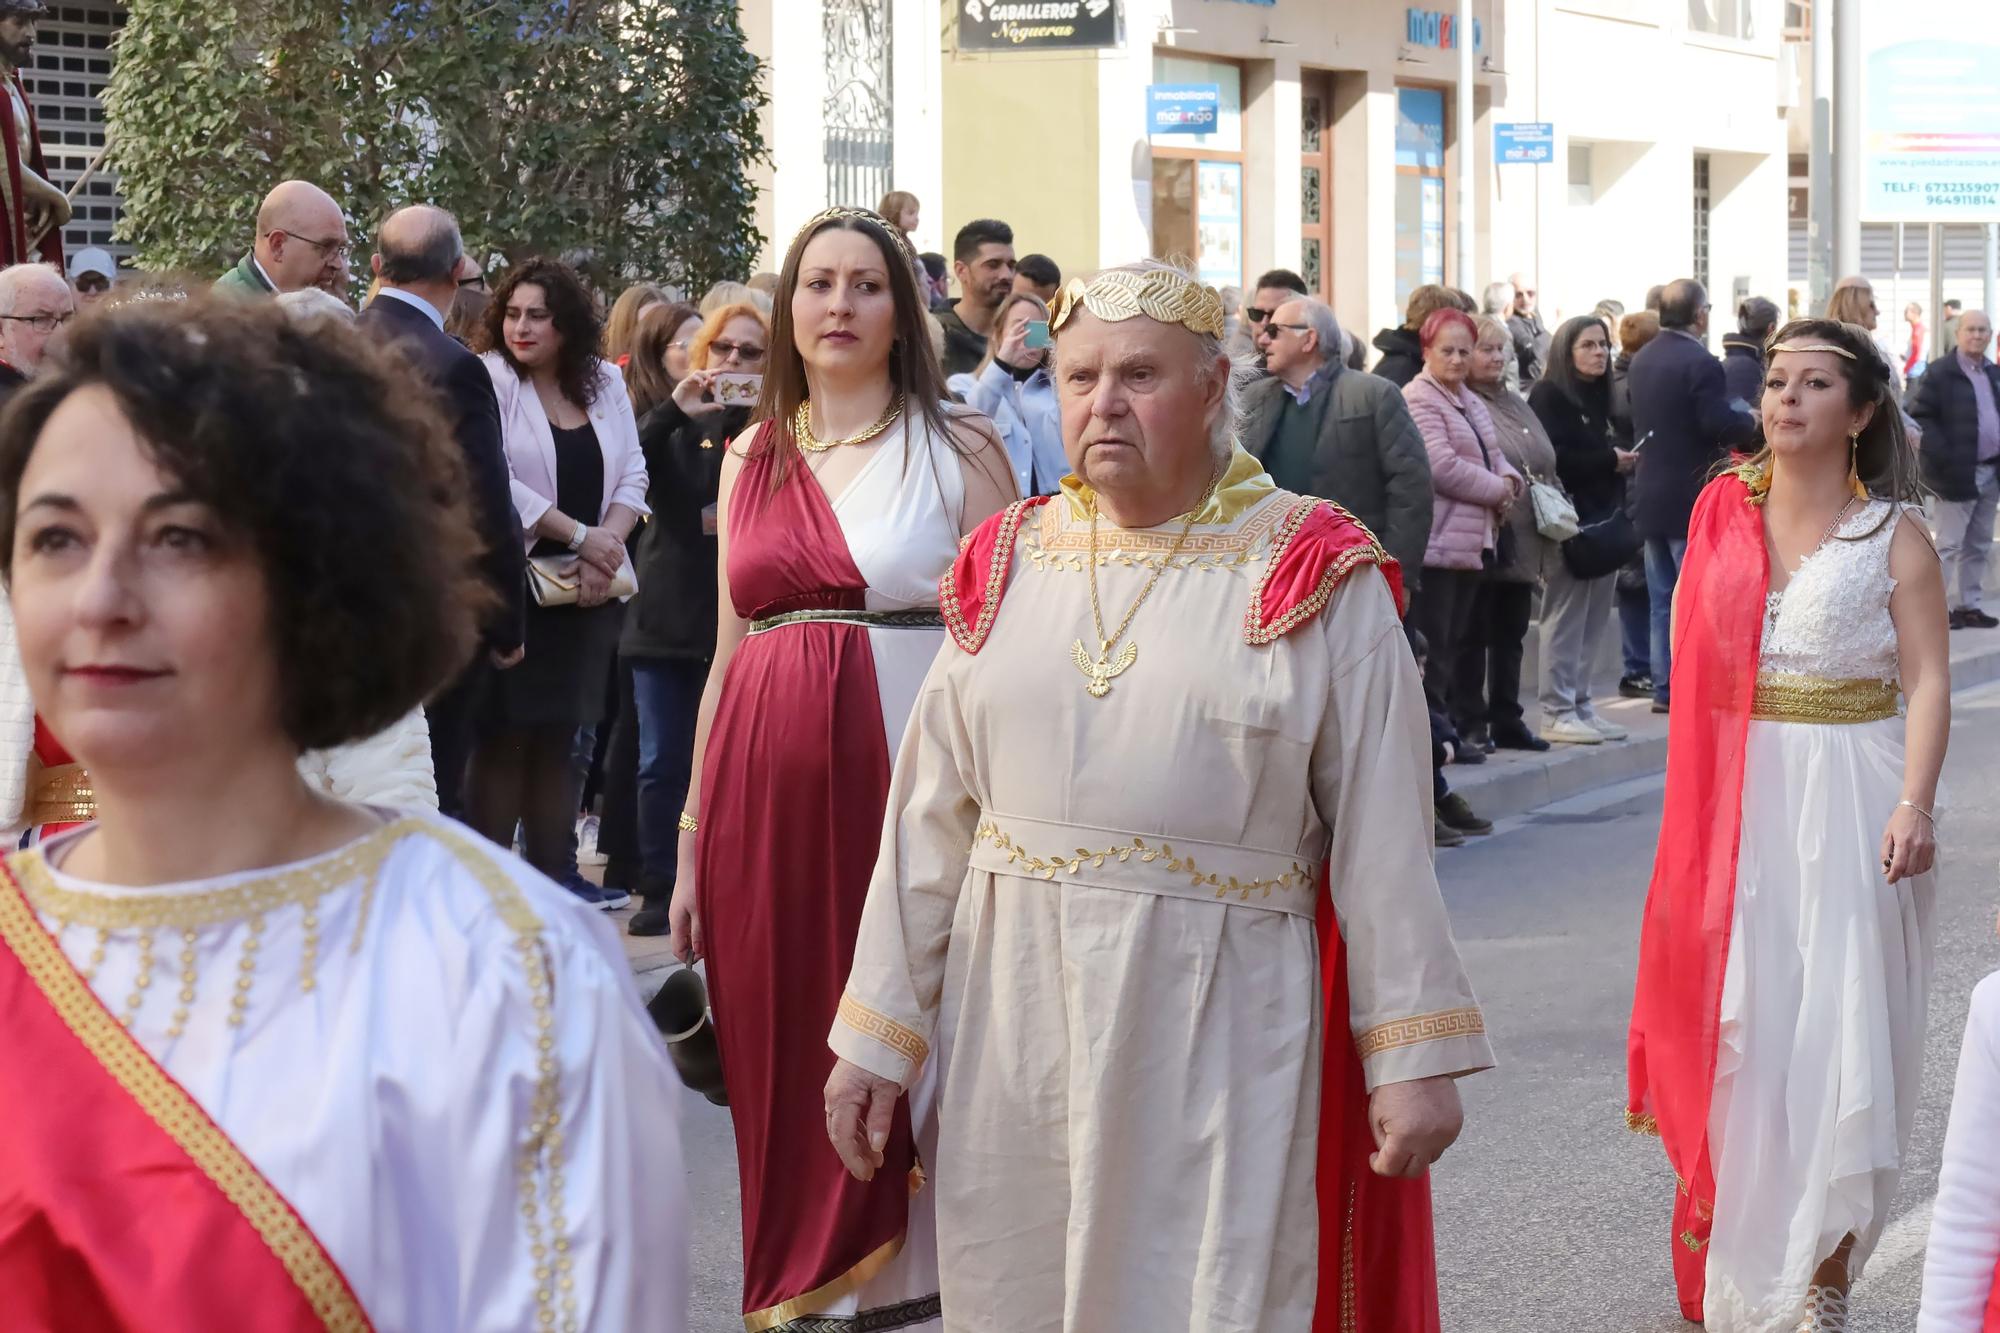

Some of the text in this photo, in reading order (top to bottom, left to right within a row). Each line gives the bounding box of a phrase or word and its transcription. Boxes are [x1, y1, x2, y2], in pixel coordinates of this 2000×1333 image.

[989, 2, 1079, 21] CABALLEROS
[991, 21, 1075, 43] Nogueras
[1882, 182, 2000, 193] TELF: 673235907
[1926, 195, 1996, 205] 964911814
